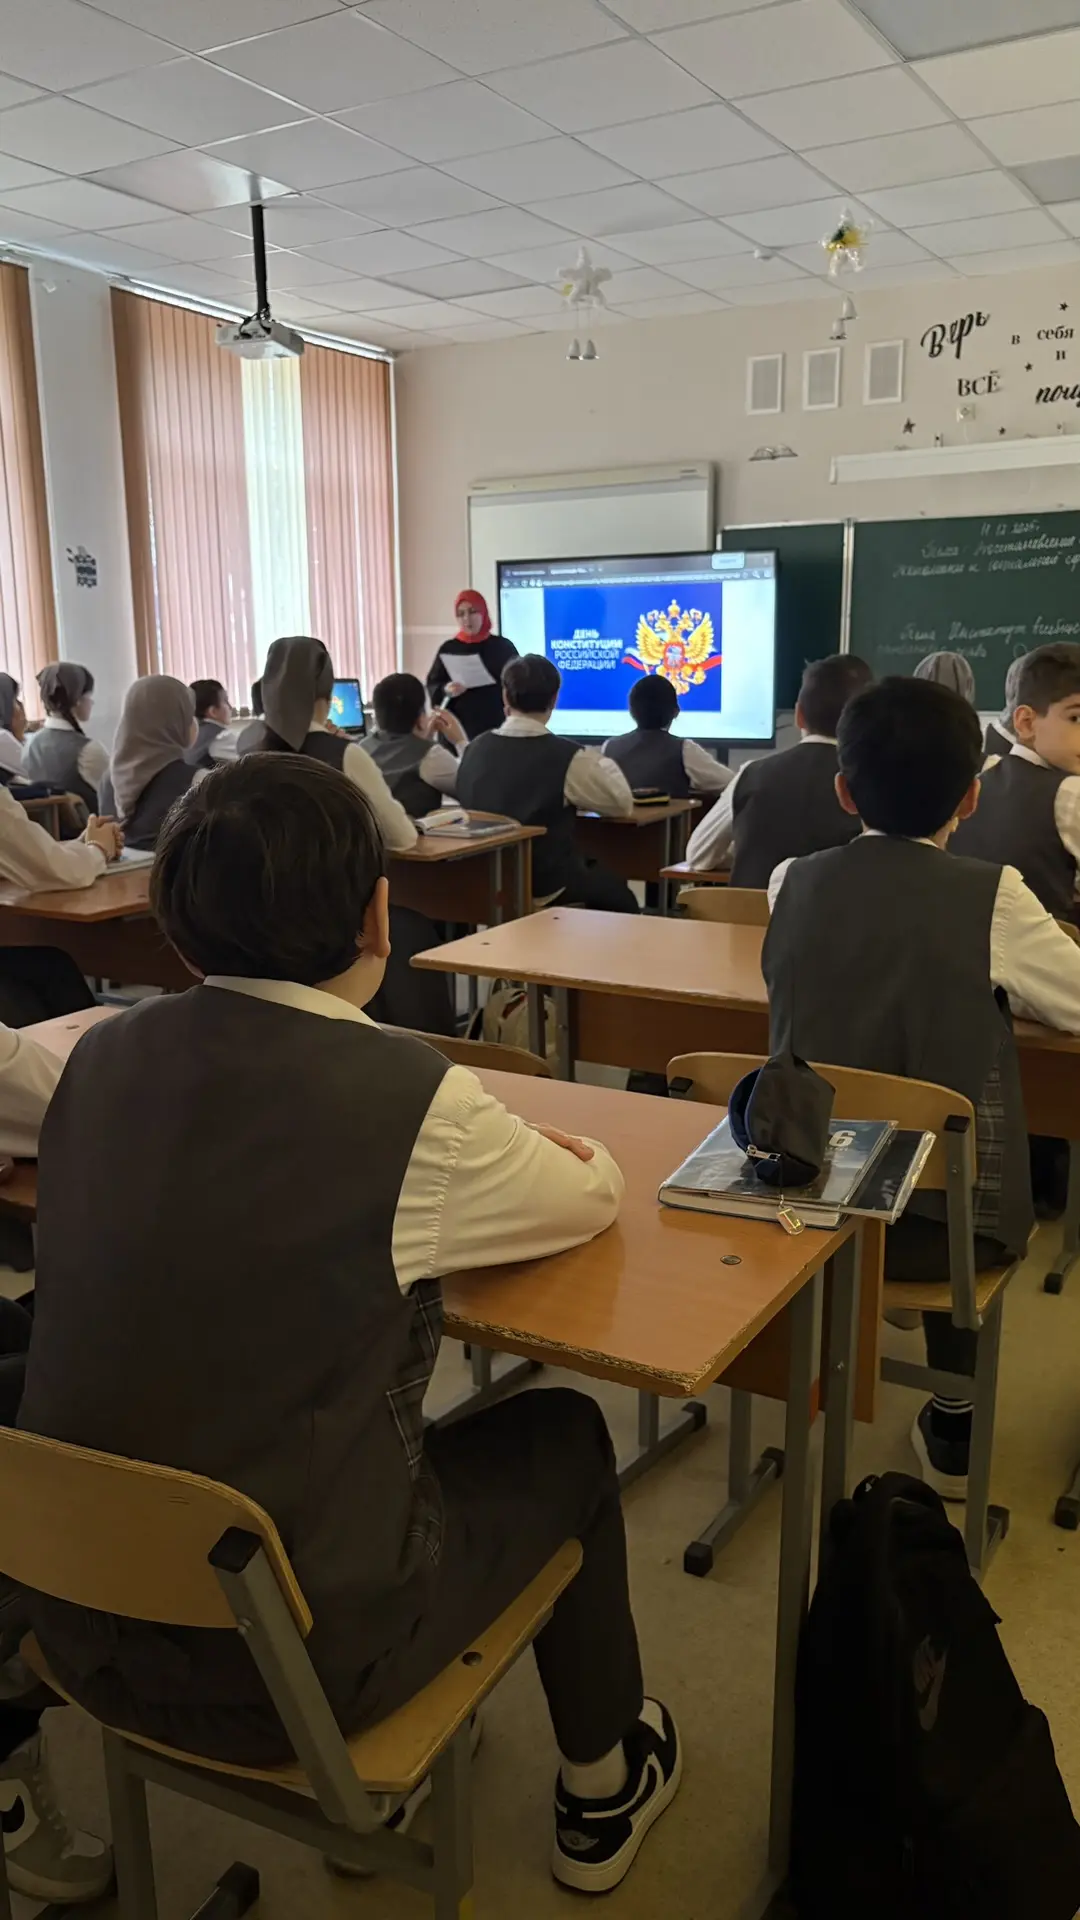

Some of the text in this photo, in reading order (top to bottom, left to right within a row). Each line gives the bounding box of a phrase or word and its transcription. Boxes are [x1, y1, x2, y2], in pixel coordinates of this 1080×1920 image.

[920, 311, 990, 360] Верь
[1036, 325, 1075, 341] себя
[957, 369, 1003, 397] ВСЁ
[573, 628, 600, 640] ДЕНЬ
[550, 639, 624, 650] КОНСТИТУЦИИ
[554, 648, 620, 660] РОССИЙСКОЙ
[557, 659, 617, 670] ФЕДЕРАЦИИ
[829, 1130, 857, 1147] 6
